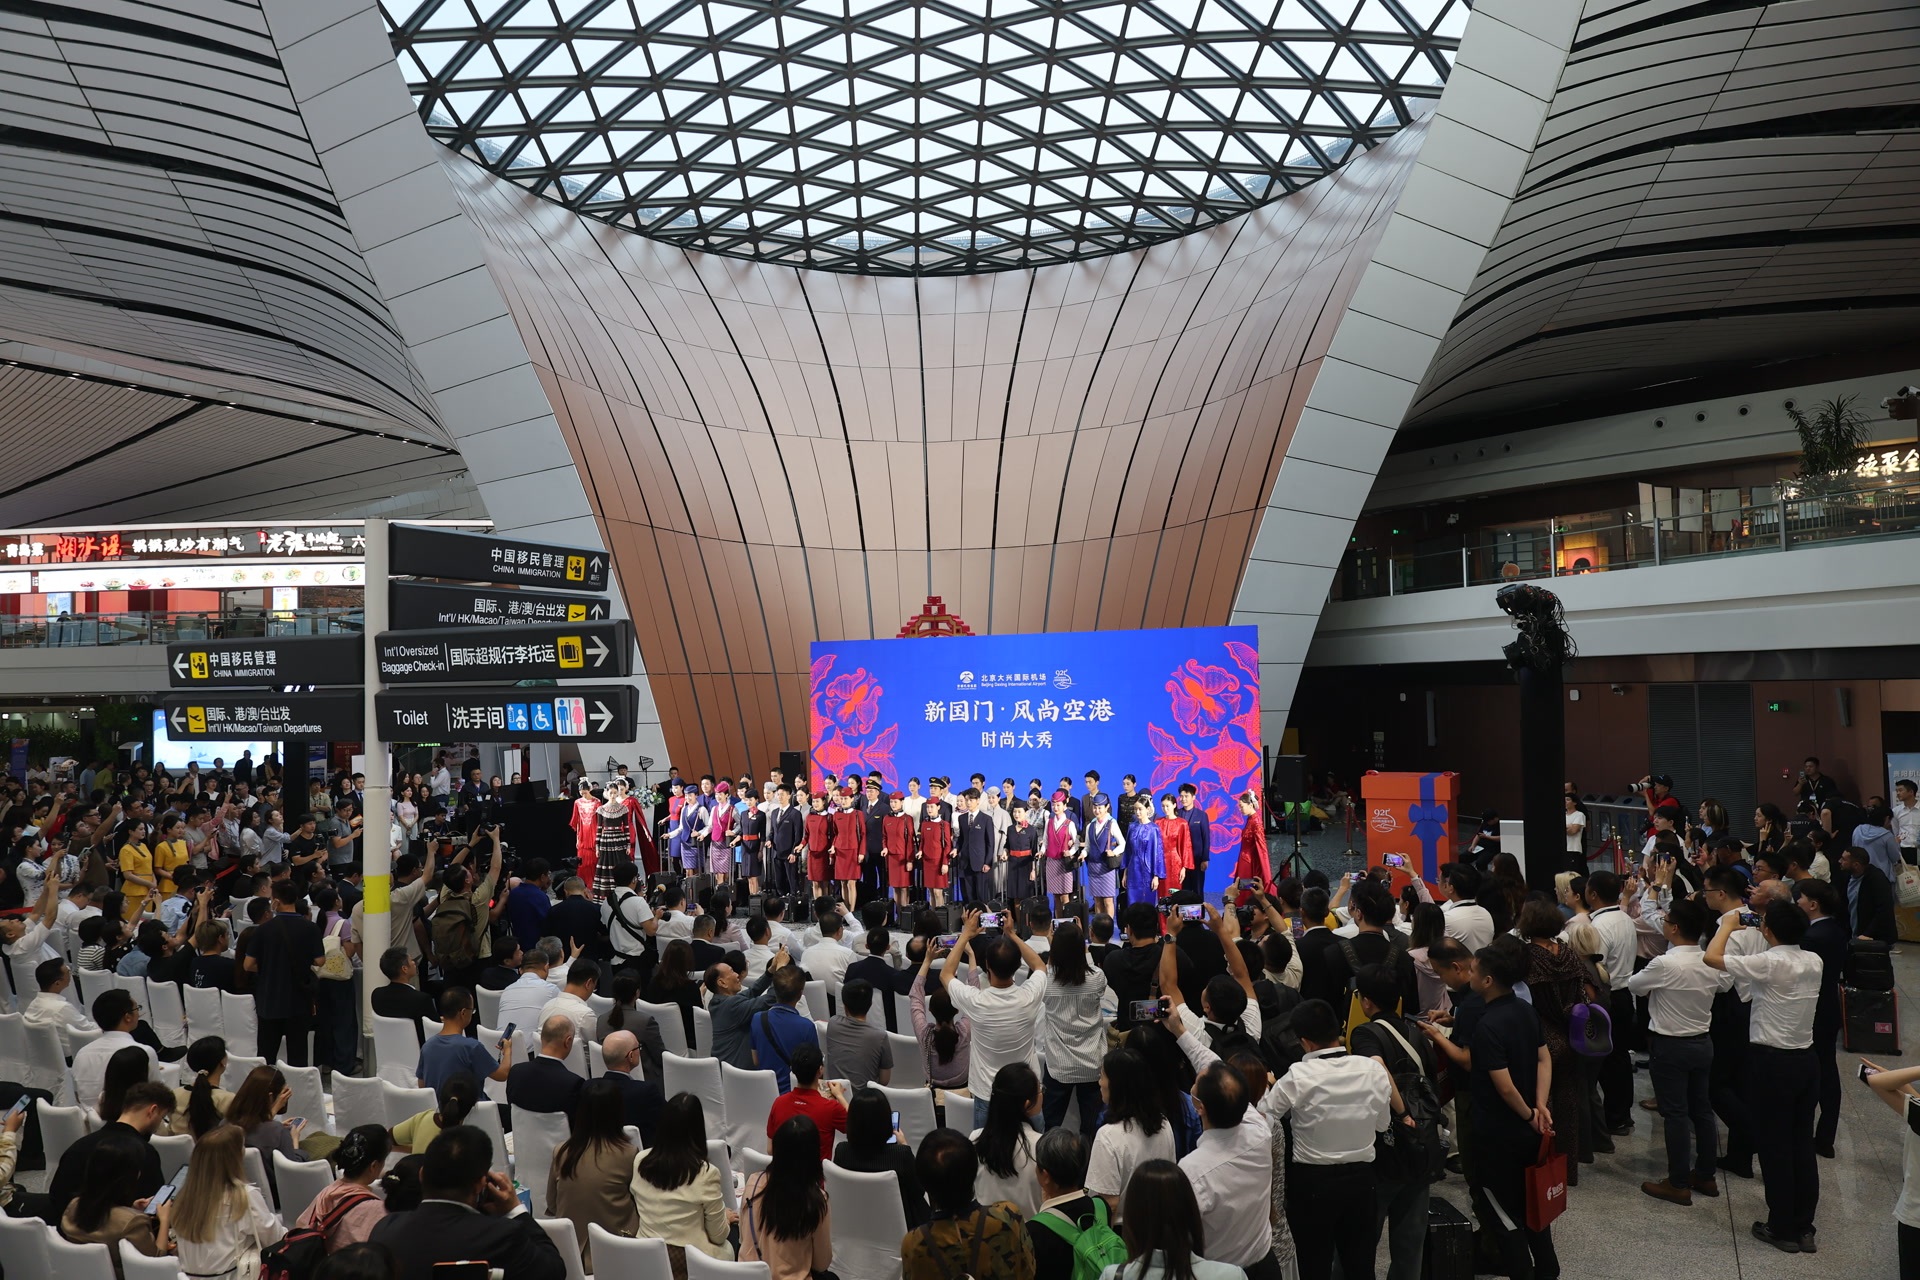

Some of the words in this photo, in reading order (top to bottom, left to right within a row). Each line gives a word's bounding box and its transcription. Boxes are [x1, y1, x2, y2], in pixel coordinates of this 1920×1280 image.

[491, 547, 565, 569] 中国移民管理
[492, 565, 515, 574] CHINA
[517, 568, 561, 578] IMMIGRATION
[474, 598, 567, 617] 国际、港/澳/台出发
[209, 650, 277, 667] 中国移民管理
[384, 646, 399, 657] Int'l
[399, 644, 439, 657] Oversized
[450, 644, 556, 666] 国际超规行李托运
[213, 669, 233, 678] CHINA
[234, 668, 276, 677] IMMIGRATION
[381, 662, 413, 675] Baggage
[413, 660, 445, 672] Check-in
[981, 673, 1047, 682] 北京大兴国际机场
[206, 706, 291, 721] 国际、港/澳/台出发
[393, 710, 429, 726] Toilet
[451, 706, 505, 729] 洗手间
[924, 698, 1116, 723] 新国门·风尚空港
[222, 723, 283, 733] HK/Macao/Taiwan
[283, 723, 322, 735] Departures
[981, 730, 1053, 749] 时尚大秀
